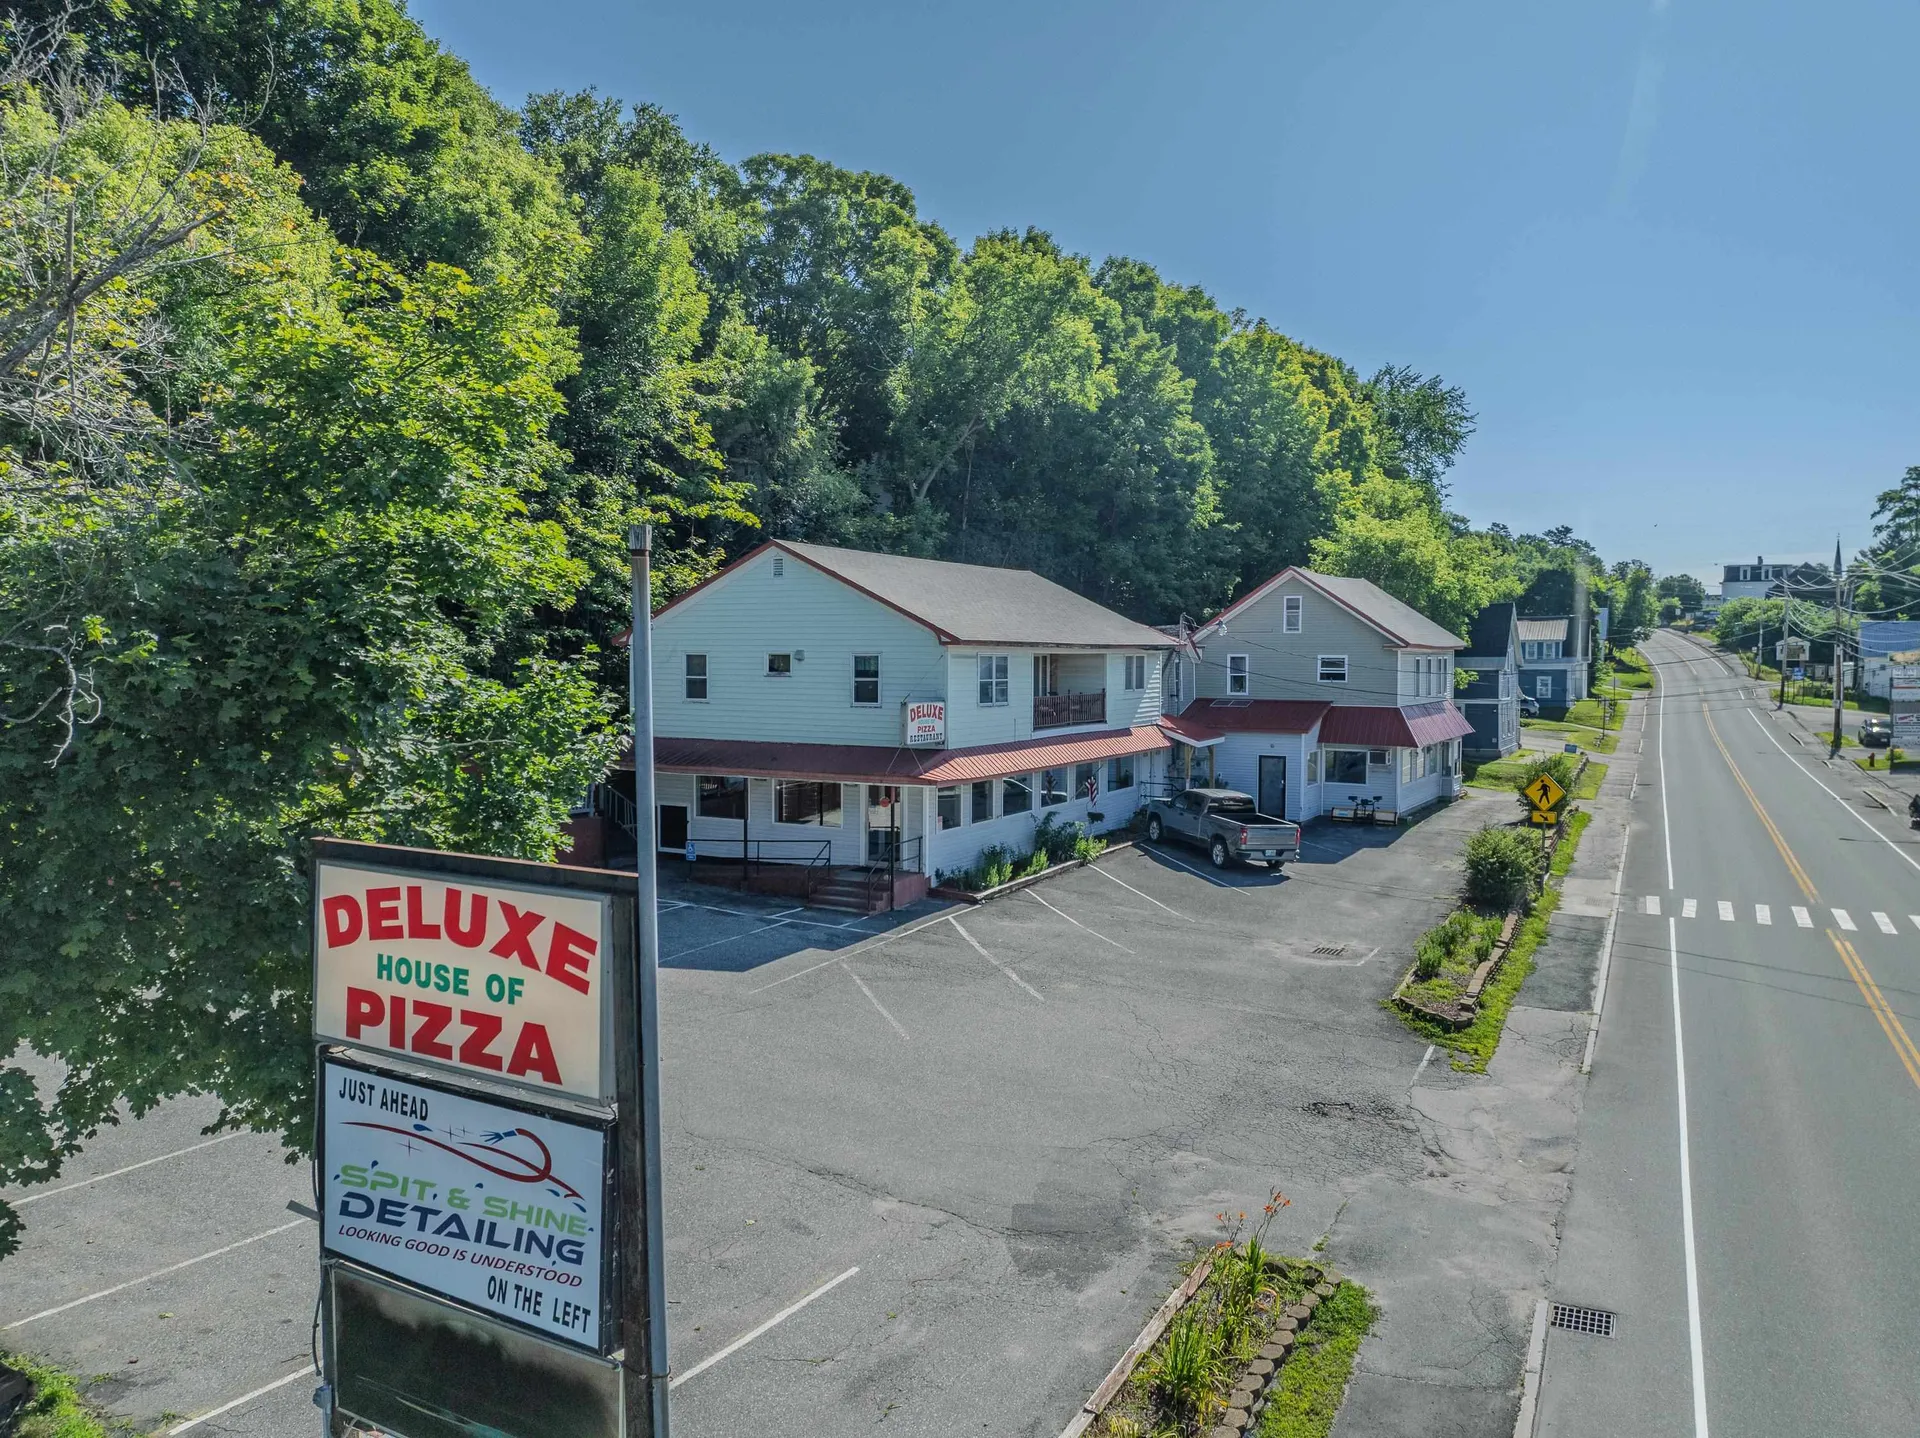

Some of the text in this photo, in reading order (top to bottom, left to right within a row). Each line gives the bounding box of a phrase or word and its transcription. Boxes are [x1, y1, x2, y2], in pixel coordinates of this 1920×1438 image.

[909, 733, 943, 742] RESTAURANT
[910, 704, 943, 722] DELUXE
[917, 725, 936, 733] PIZZA
[322, 886, 598, 996] DELUXE
[377, 953, 525, 1005] HOUSE OF
[345, 986, 563, 1086] PIZZA
[339, 1077, 429, 1121] JUST AHEAD
[339, 1191, 586, 1266] DETAILING
[340, 1164, 588, 1237] SPIT & SHINE
[339, 1224, 583, 1287] LOOKING GOOD IS UNDERSTOOD
[487, 1275, 591, 1333] ON THE LEFT
